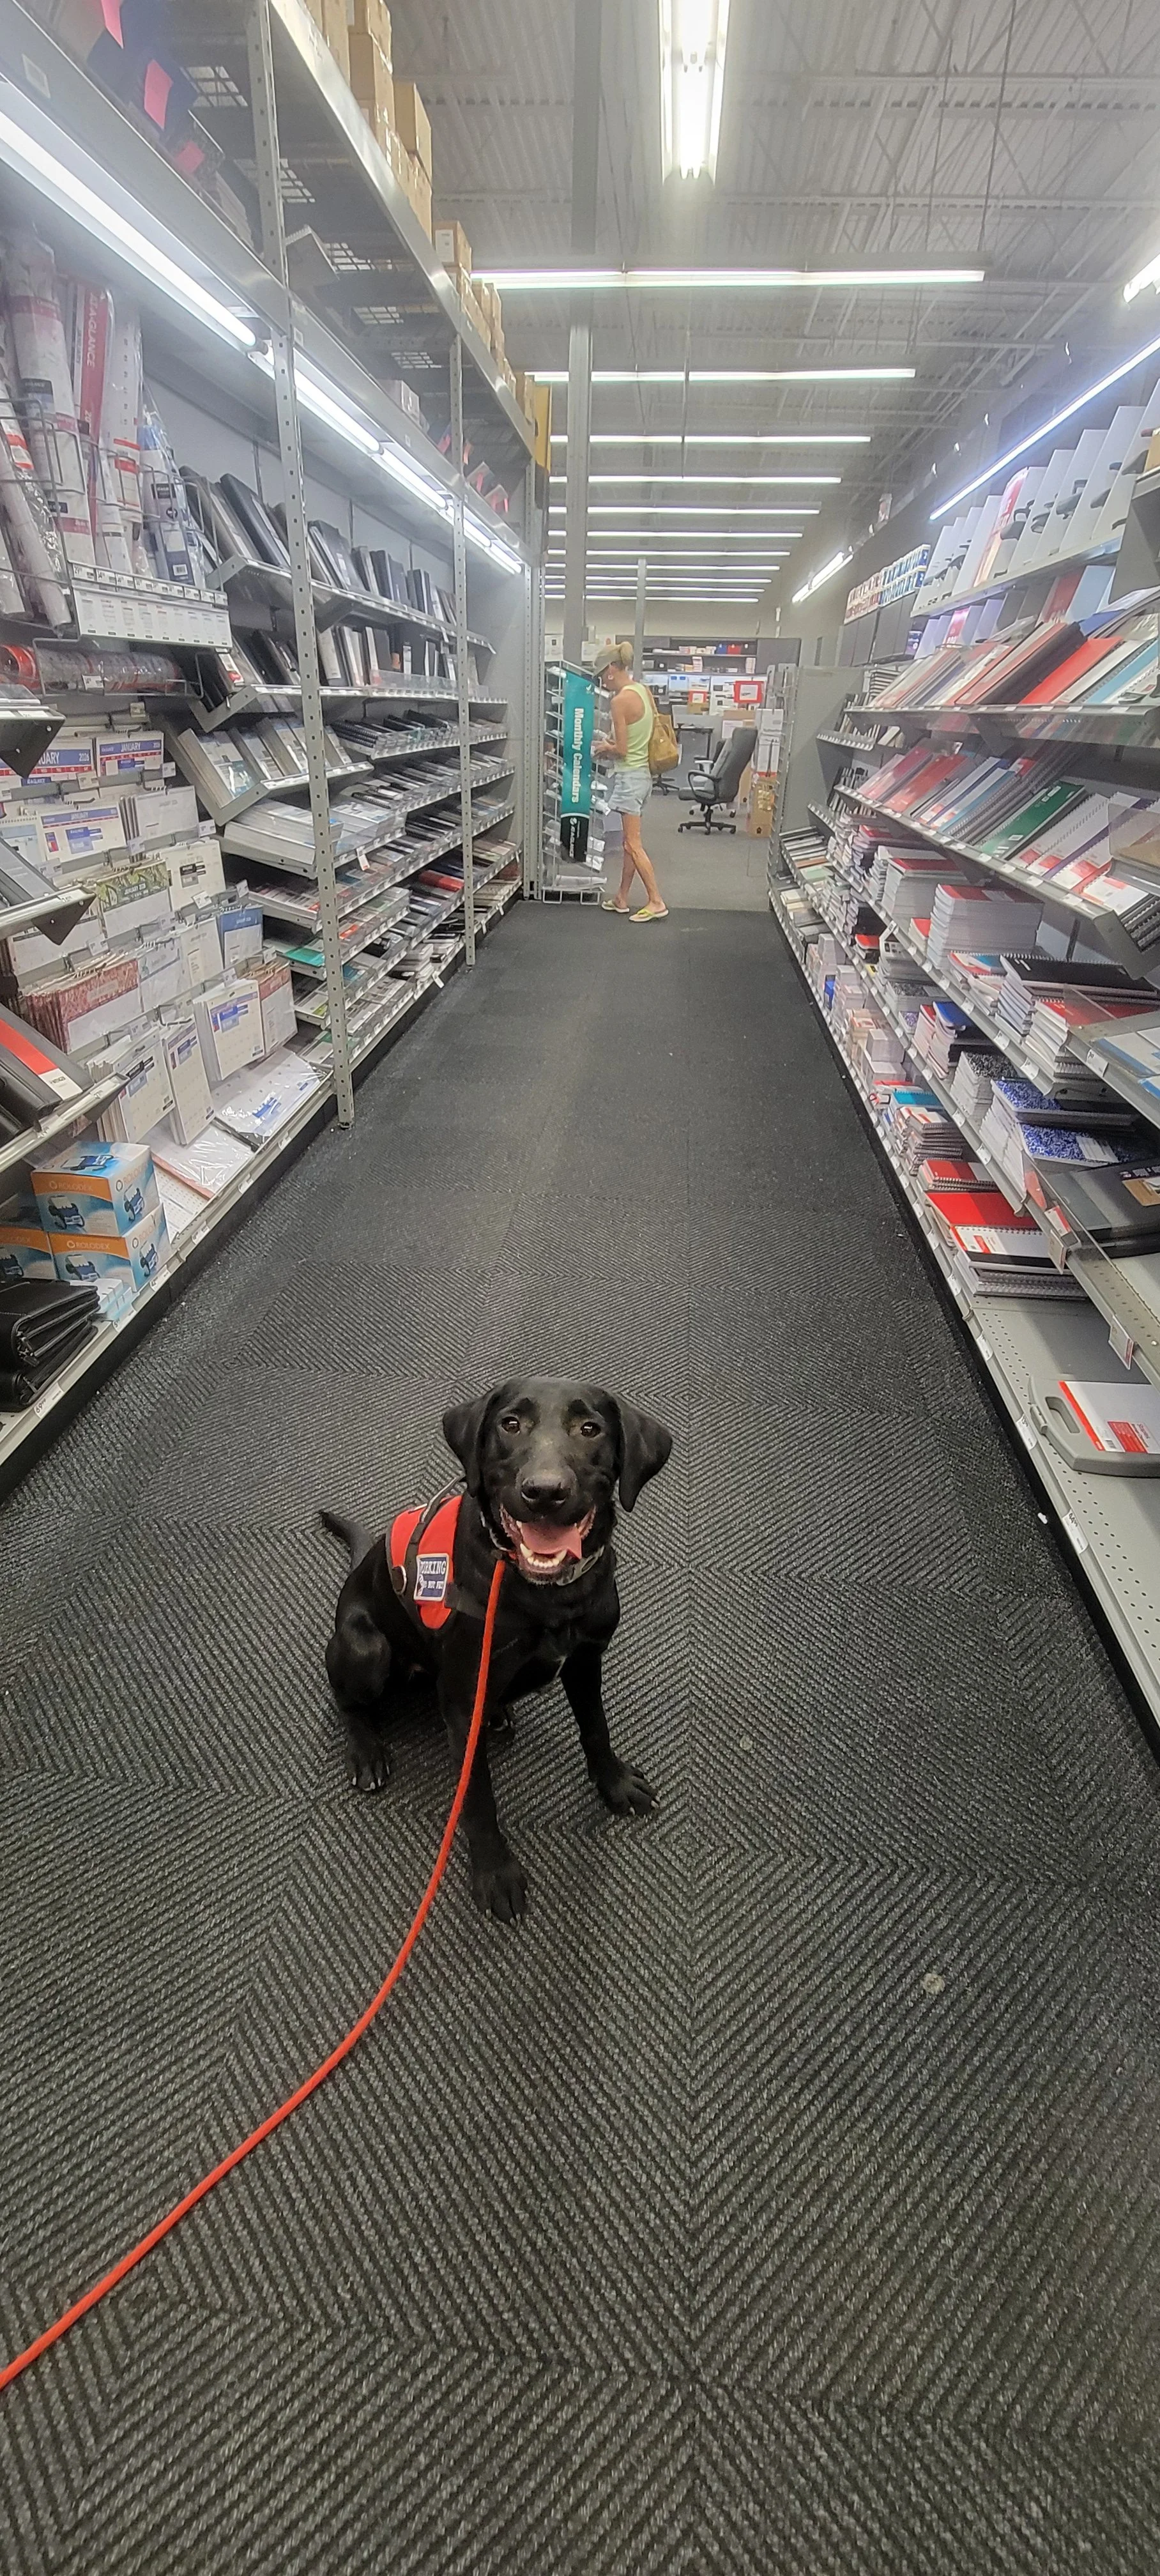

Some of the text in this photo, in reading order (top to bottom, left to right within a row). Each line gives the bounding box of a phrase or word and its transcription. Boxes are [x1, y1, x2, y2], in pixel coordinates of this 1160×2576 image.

[121, 742, 141, 753] JANUARY
[38, 751, 89, 765] UARY 2026
[572, 709, 584, 803] Monthly Calendars
[59, 1183, 93, 1192] ROLODEX
[75, 1241, 111, 1250] ROLODEX
